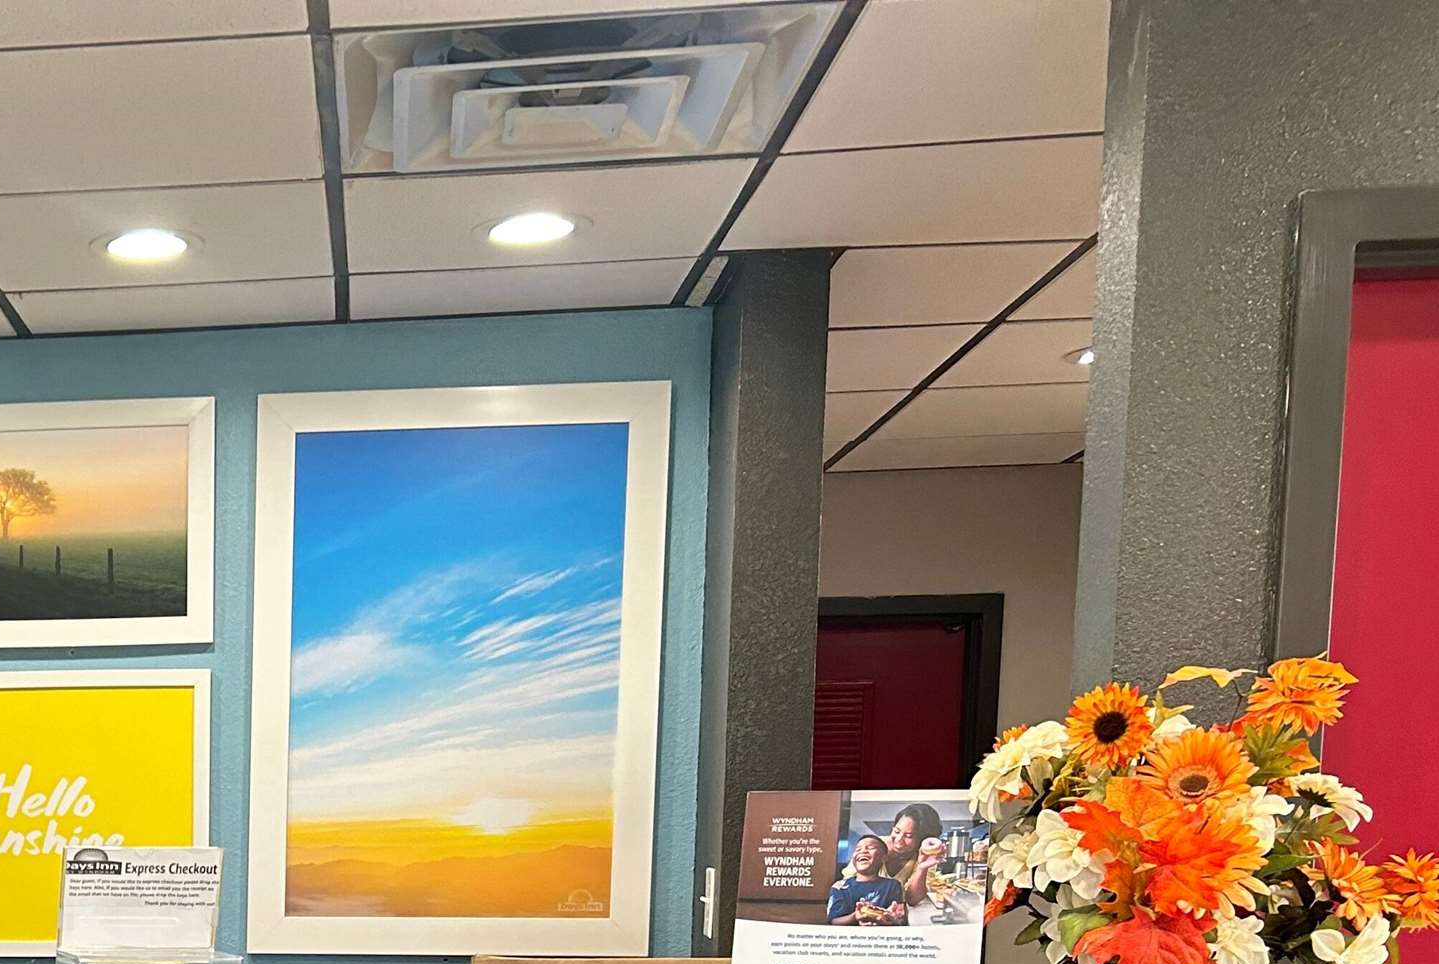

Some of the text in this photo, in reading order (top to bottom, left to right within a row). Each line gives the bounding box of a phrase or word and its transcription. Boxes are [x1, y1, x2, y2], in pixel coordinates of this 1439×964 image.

[789, 838, 808, 846] you're
[785, 846, 806, 854] savory
[96, 862, 119, 870] Inn
[764, 856, 815, 866] WYNDHAM
[124, 862, 218, 877] Express Checkout
[766, 866, 812, 877] REWARDS
[763, 876, 814, 887] EVERYONE.
